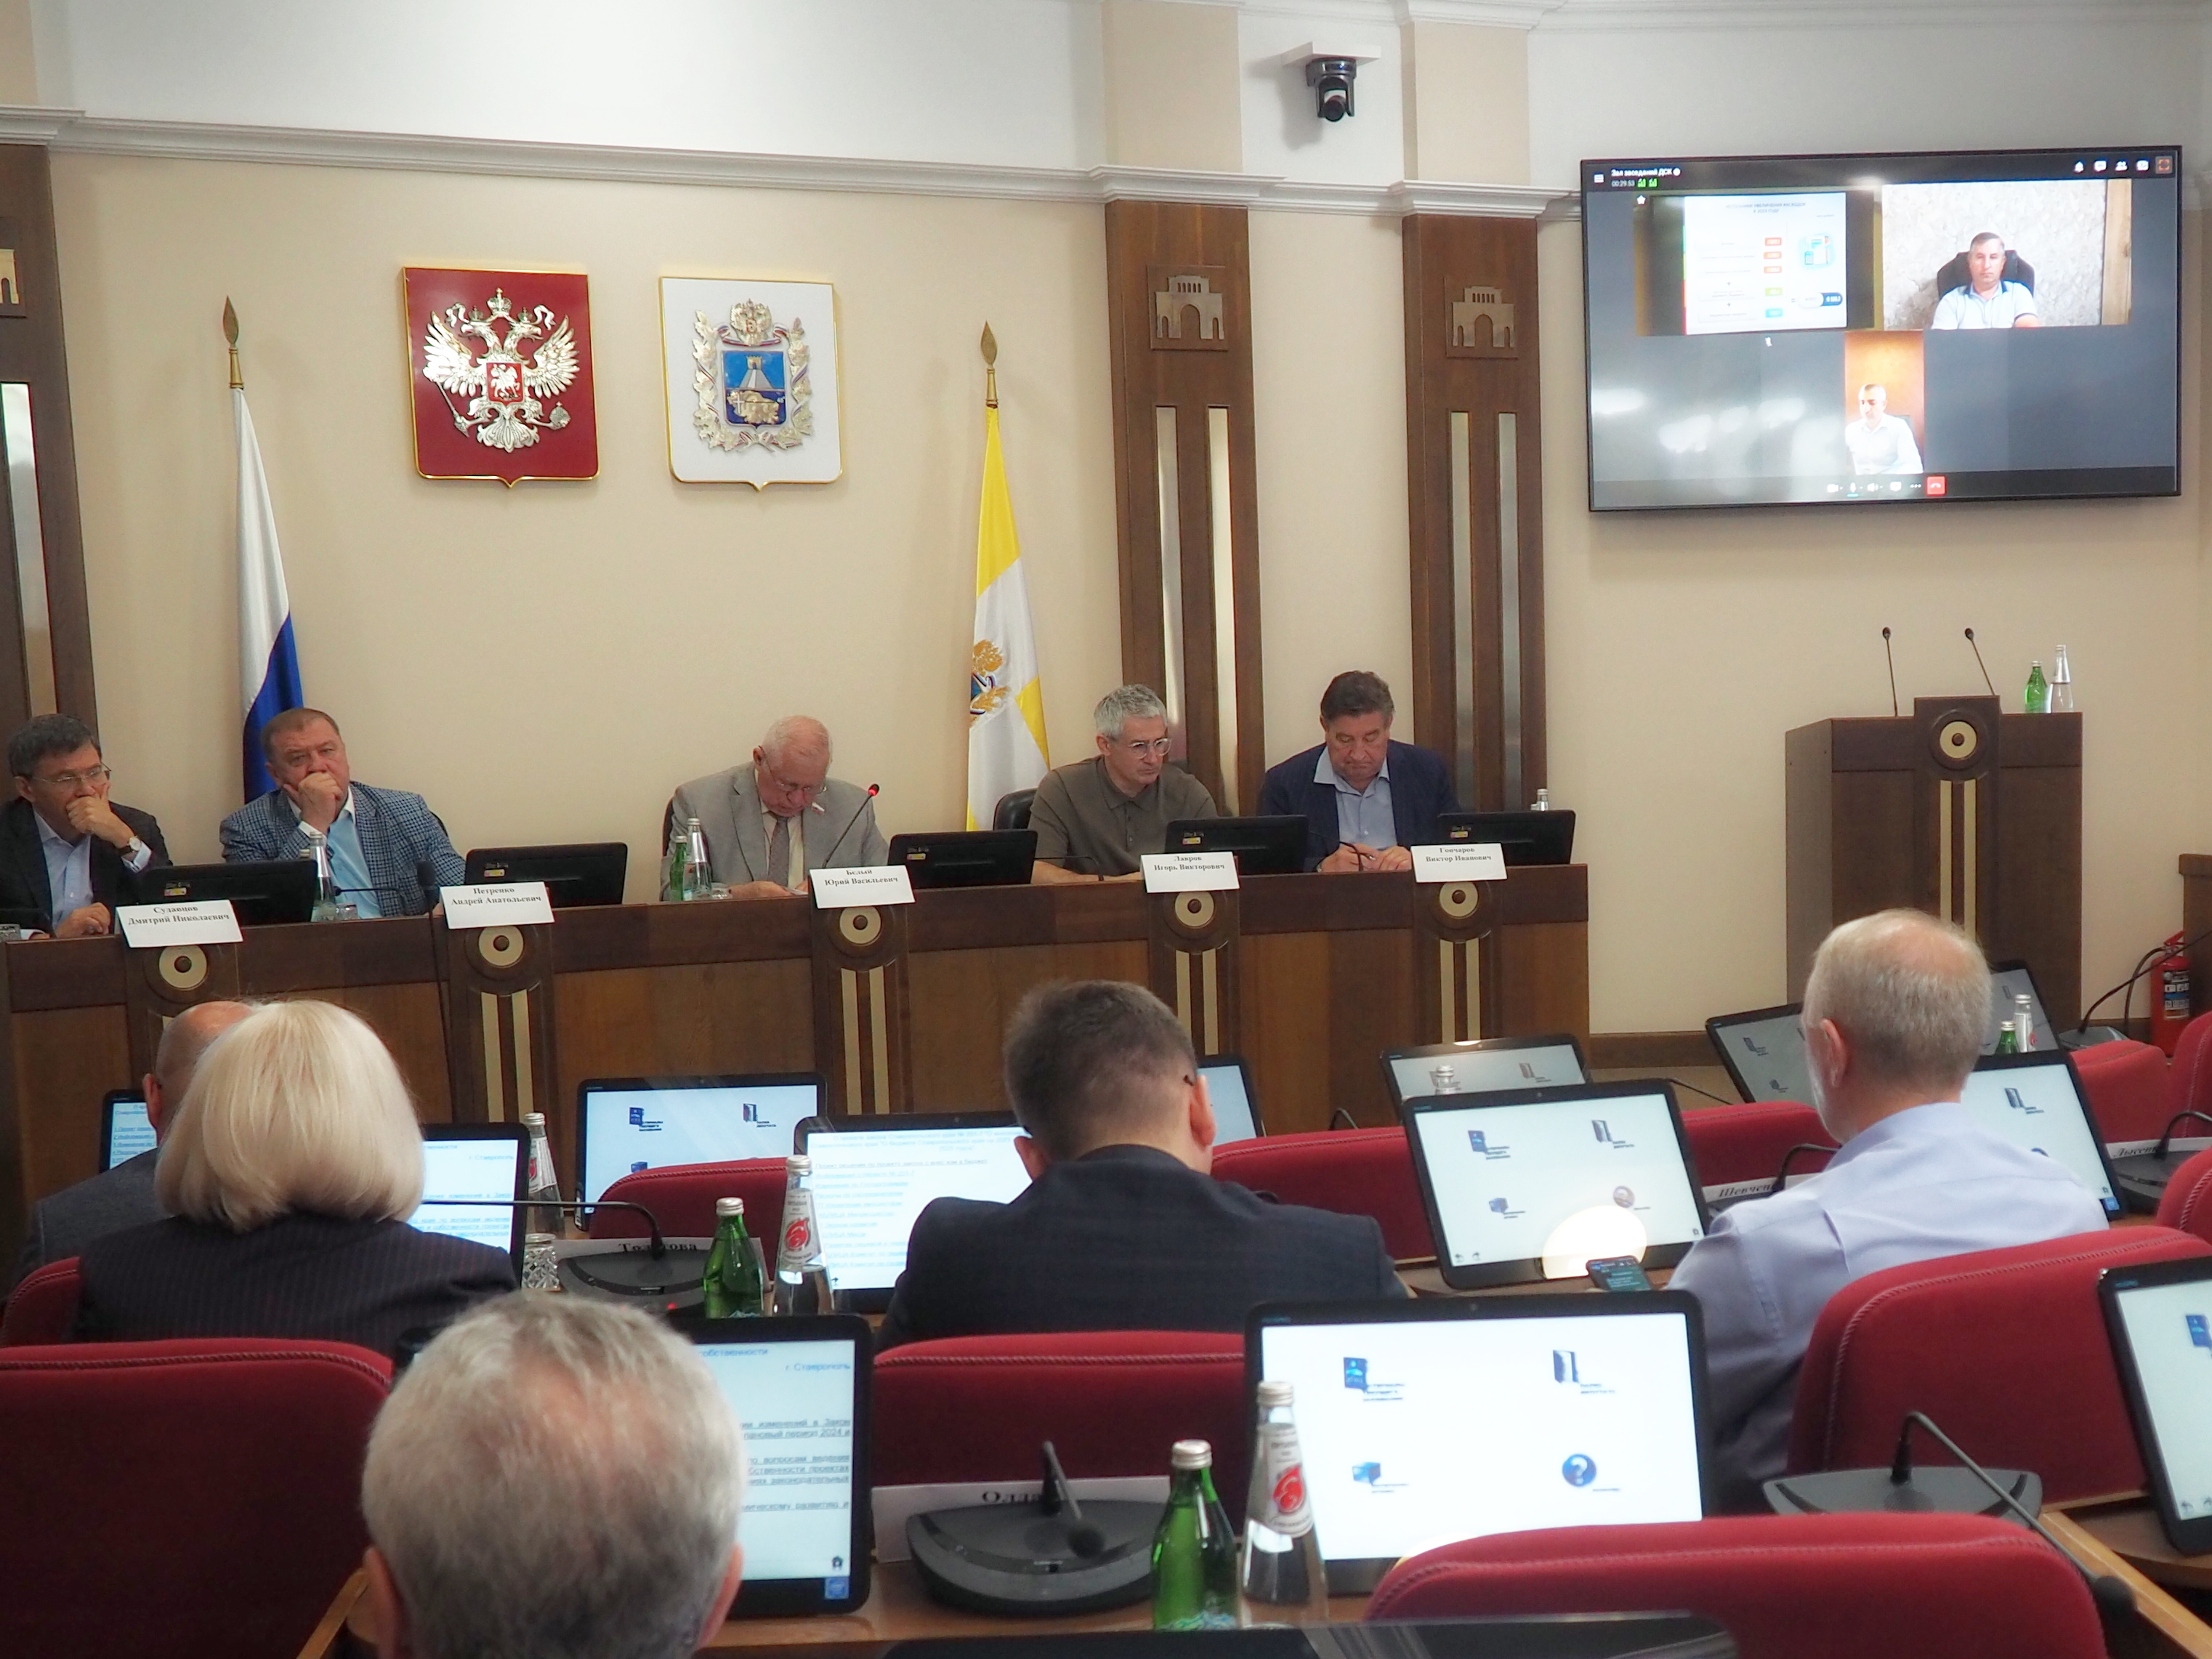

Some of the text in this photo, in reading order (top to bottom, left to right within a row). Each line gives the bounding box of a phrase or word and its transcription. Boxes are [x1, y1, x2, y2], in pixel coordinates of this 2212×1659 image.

[1624, 168, 1658, 177] заседаний
[824, 876, 898, 887] Юрий Васильевич
[451, 895, 541, 906] Андрей Анатольевич
[153, 905, 198, 915] Судавцов
[128, 913, 230, 925] Дмитрий Николаевич
[2112, 1147, 2157, 1157] Лысен
[1719, 1184, 1773, 1198] Шевчен
[794, 1363, 850, 1373] Ставрополь
[758, 1419, 807, 1428] изменений
[824, 1418, 850, 1427] Закон
[786, 1430, 818, 1439] период
[819, 1428, 841, 1438] 2024
[770, 1476, 849, 1485] законодательных
[795, 1502, 839, 1511] развитию
